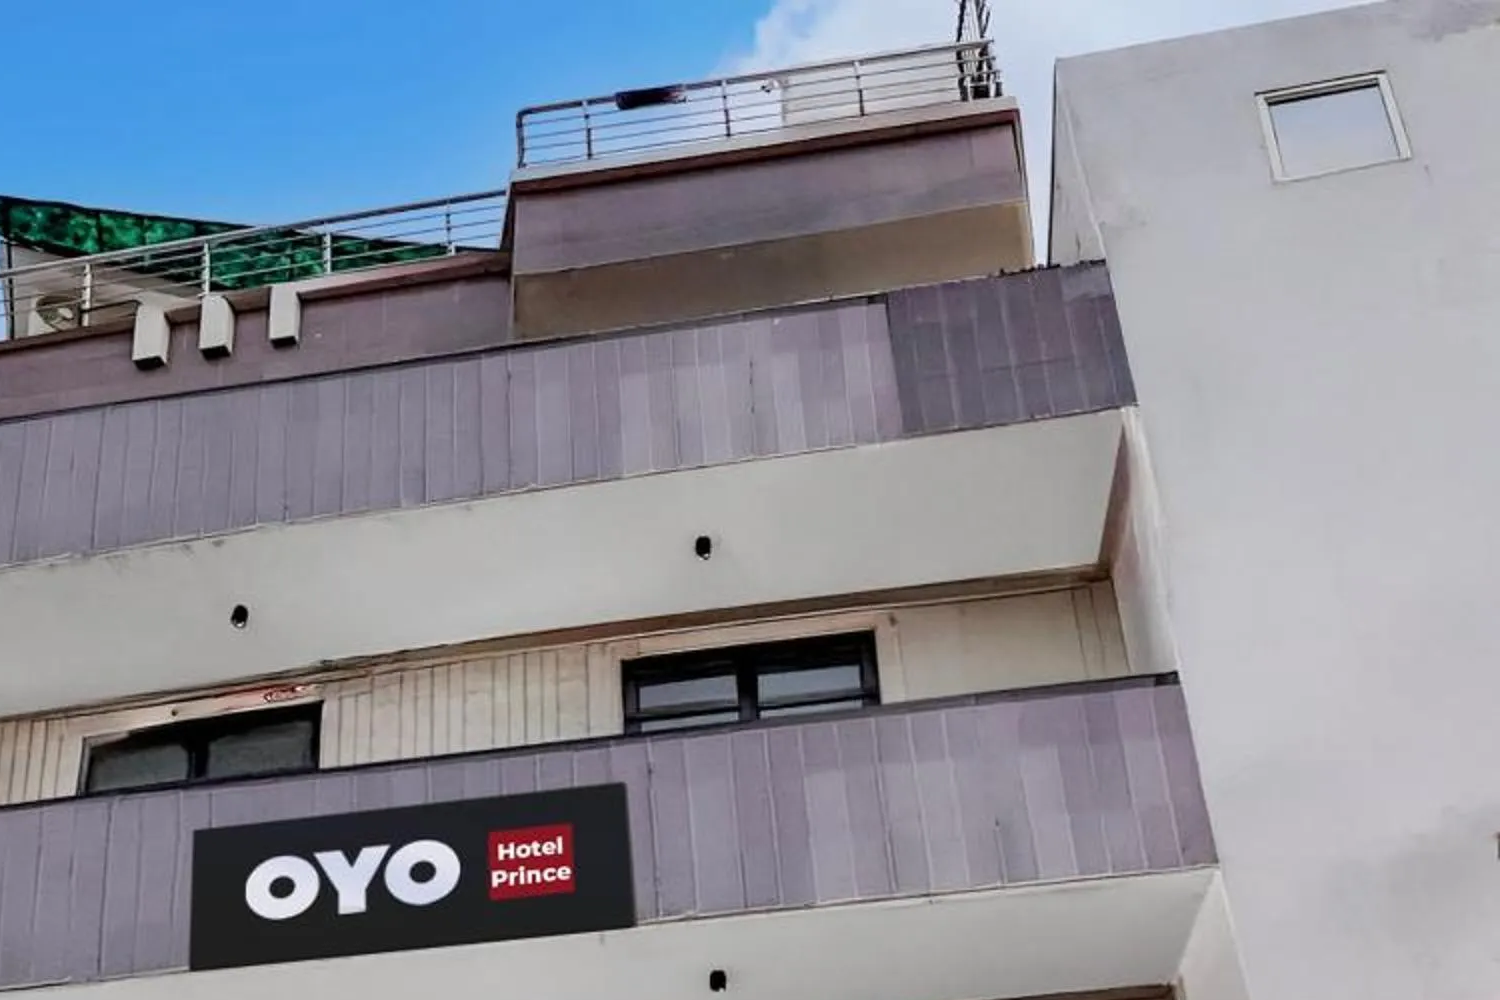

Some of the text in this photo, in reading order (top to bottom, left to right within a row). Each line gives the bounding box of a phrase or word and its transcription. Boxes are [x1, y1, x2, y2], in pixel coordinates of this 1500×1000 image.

[497, 835, 563, 861] Hotel
[245, 839, 461, 920] OYO
[491, 865, 572, 888] Prince
